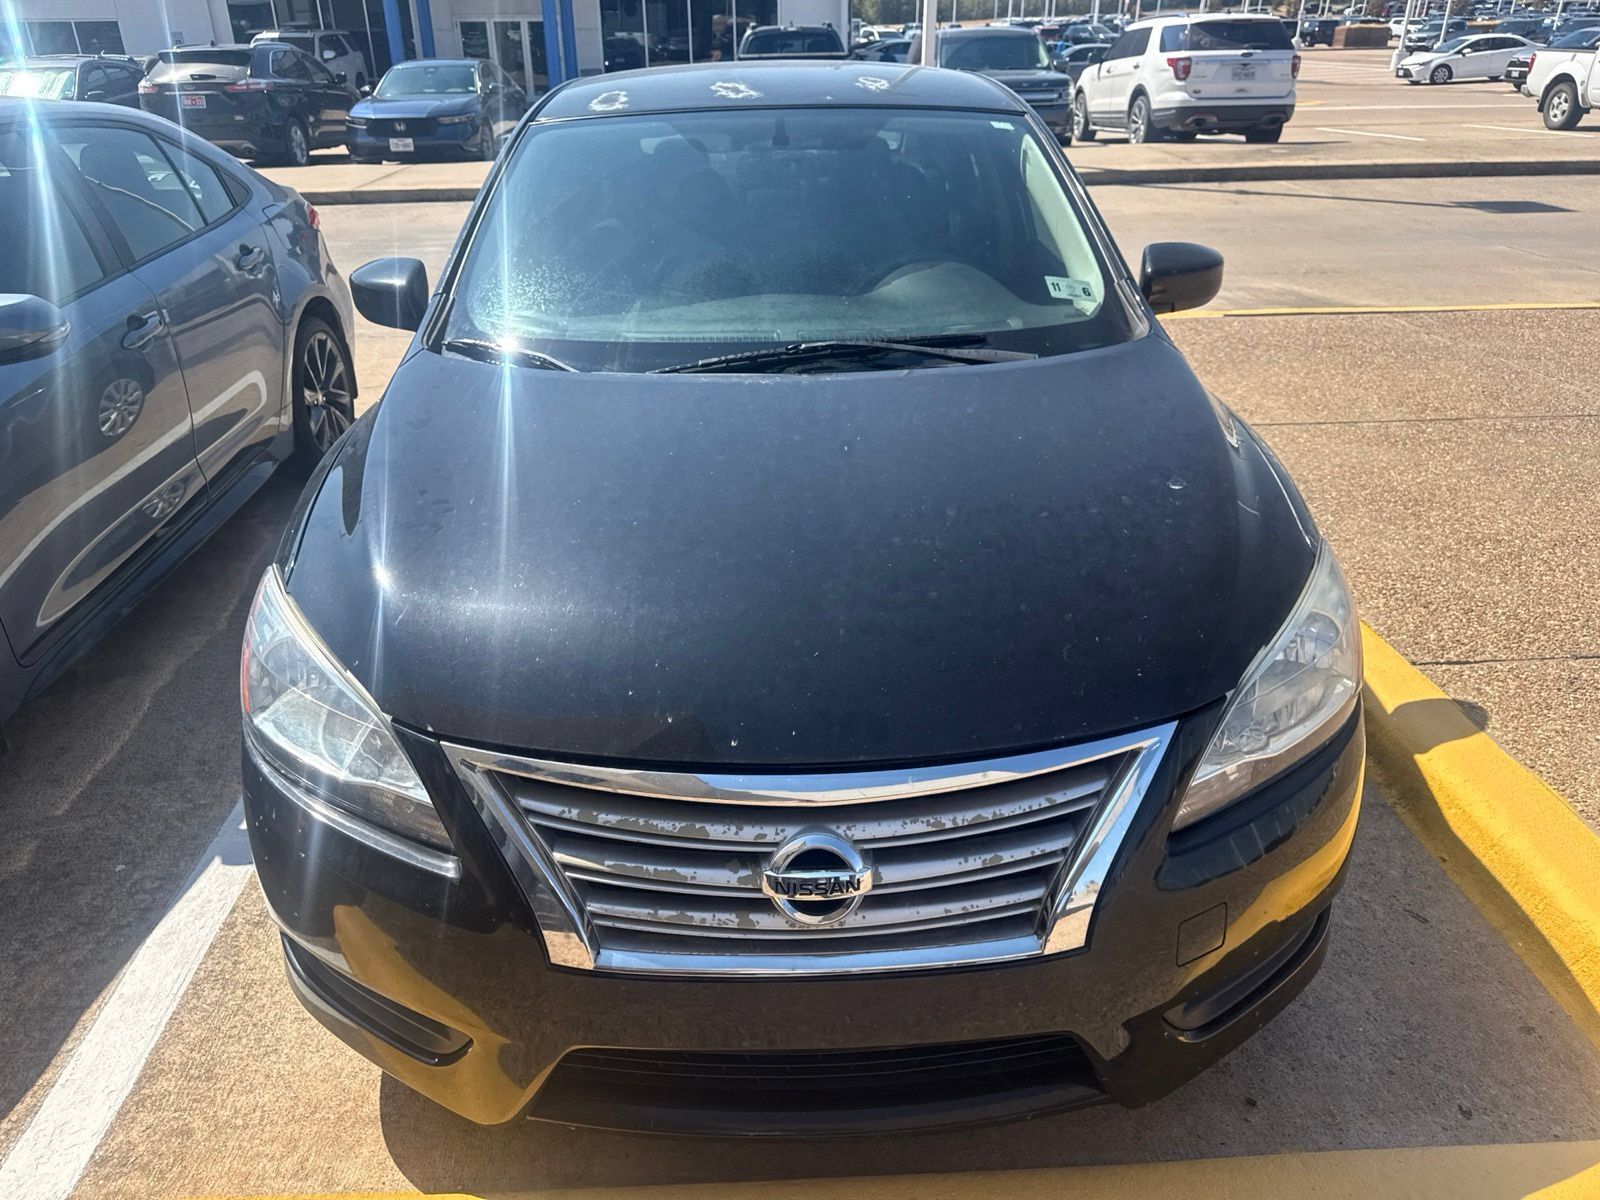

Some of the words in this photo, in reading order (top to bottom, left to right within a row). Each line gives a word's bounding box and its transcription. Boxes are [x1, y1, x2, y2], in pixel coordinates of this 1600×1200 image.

[1051, 282, 1061, 292] 11
[1082, 287, 1091, 296] 6
[774, 876, 861, 896] NISSAN
